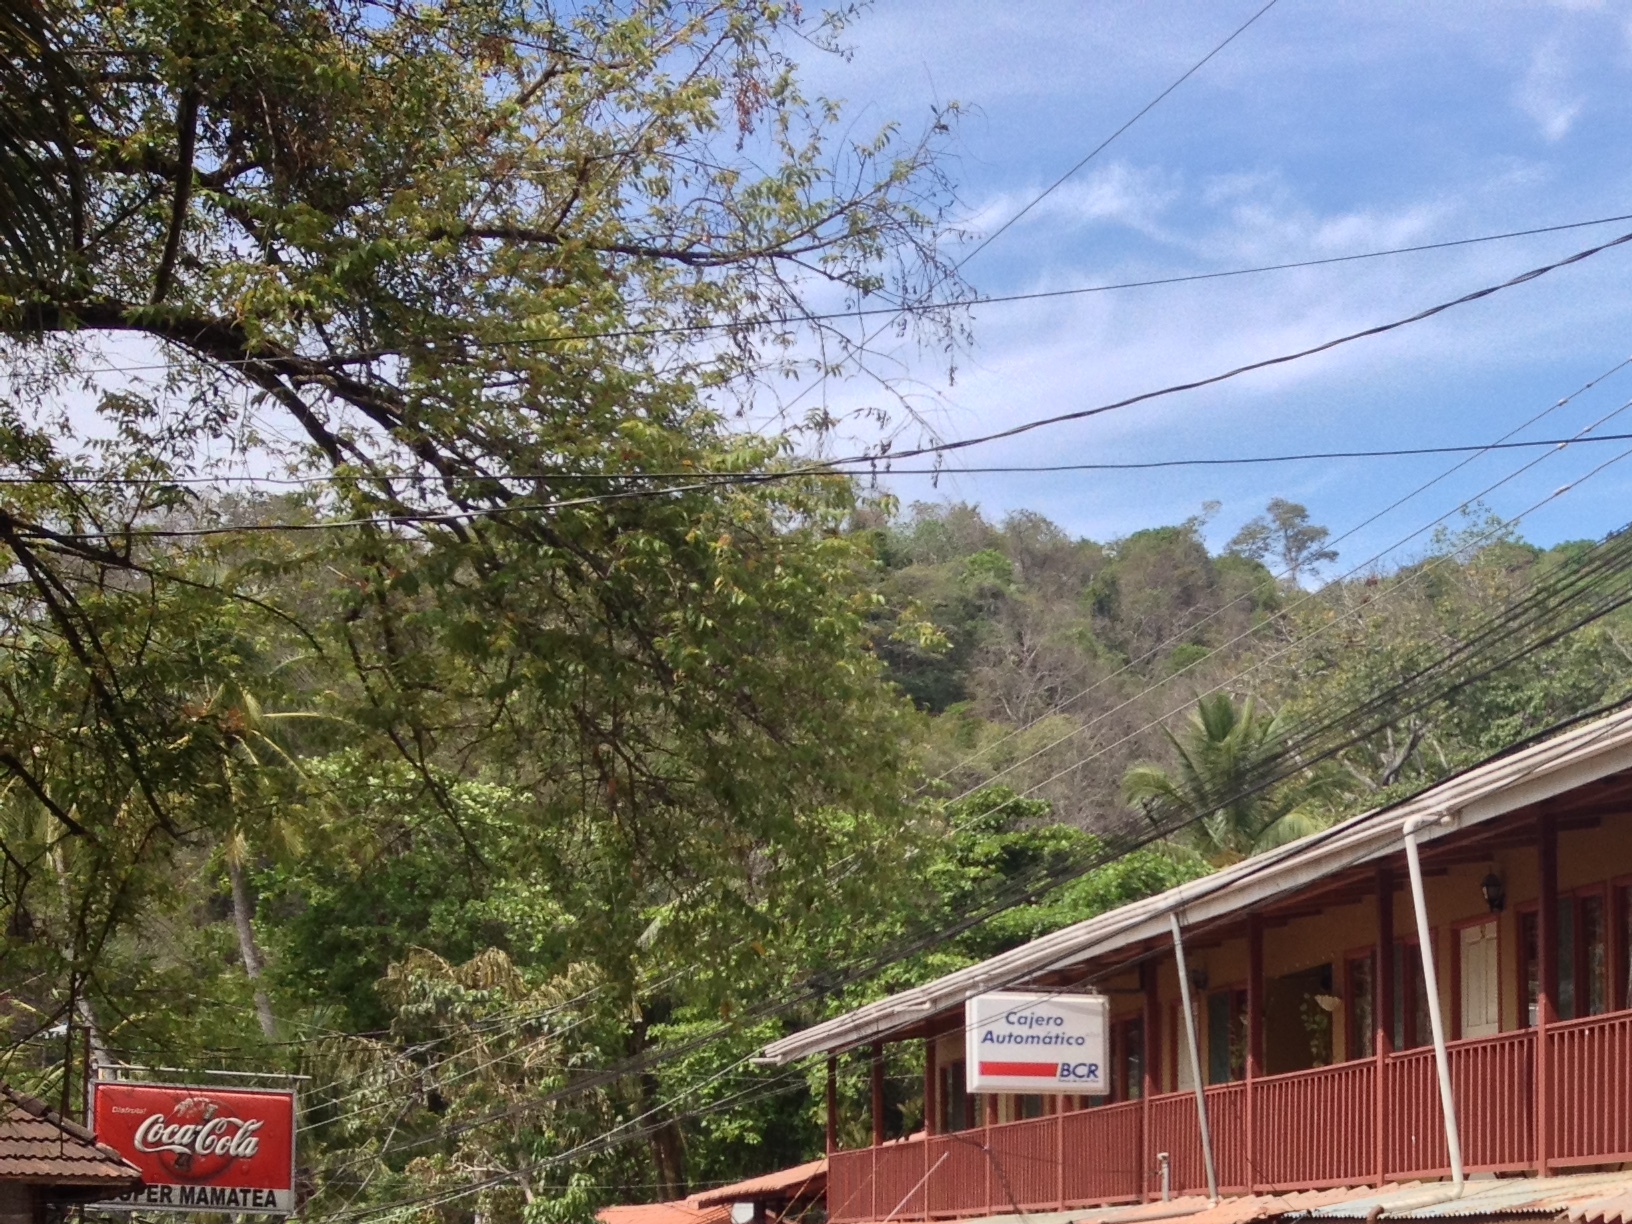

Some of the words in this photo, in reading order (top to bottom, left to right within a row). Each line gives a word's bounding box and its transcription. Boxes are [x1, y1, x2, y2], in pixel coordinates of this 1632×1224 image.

[1005, 1011, 1064, 1030] Cajero
[981, 1030, 1086, 1046] Automático
[1060, 1062, 1099, 1079] BCR
[133, 1113, 265, 1158] Coca-Cola
[179, 1185, 278, 1208] MAMATEA
